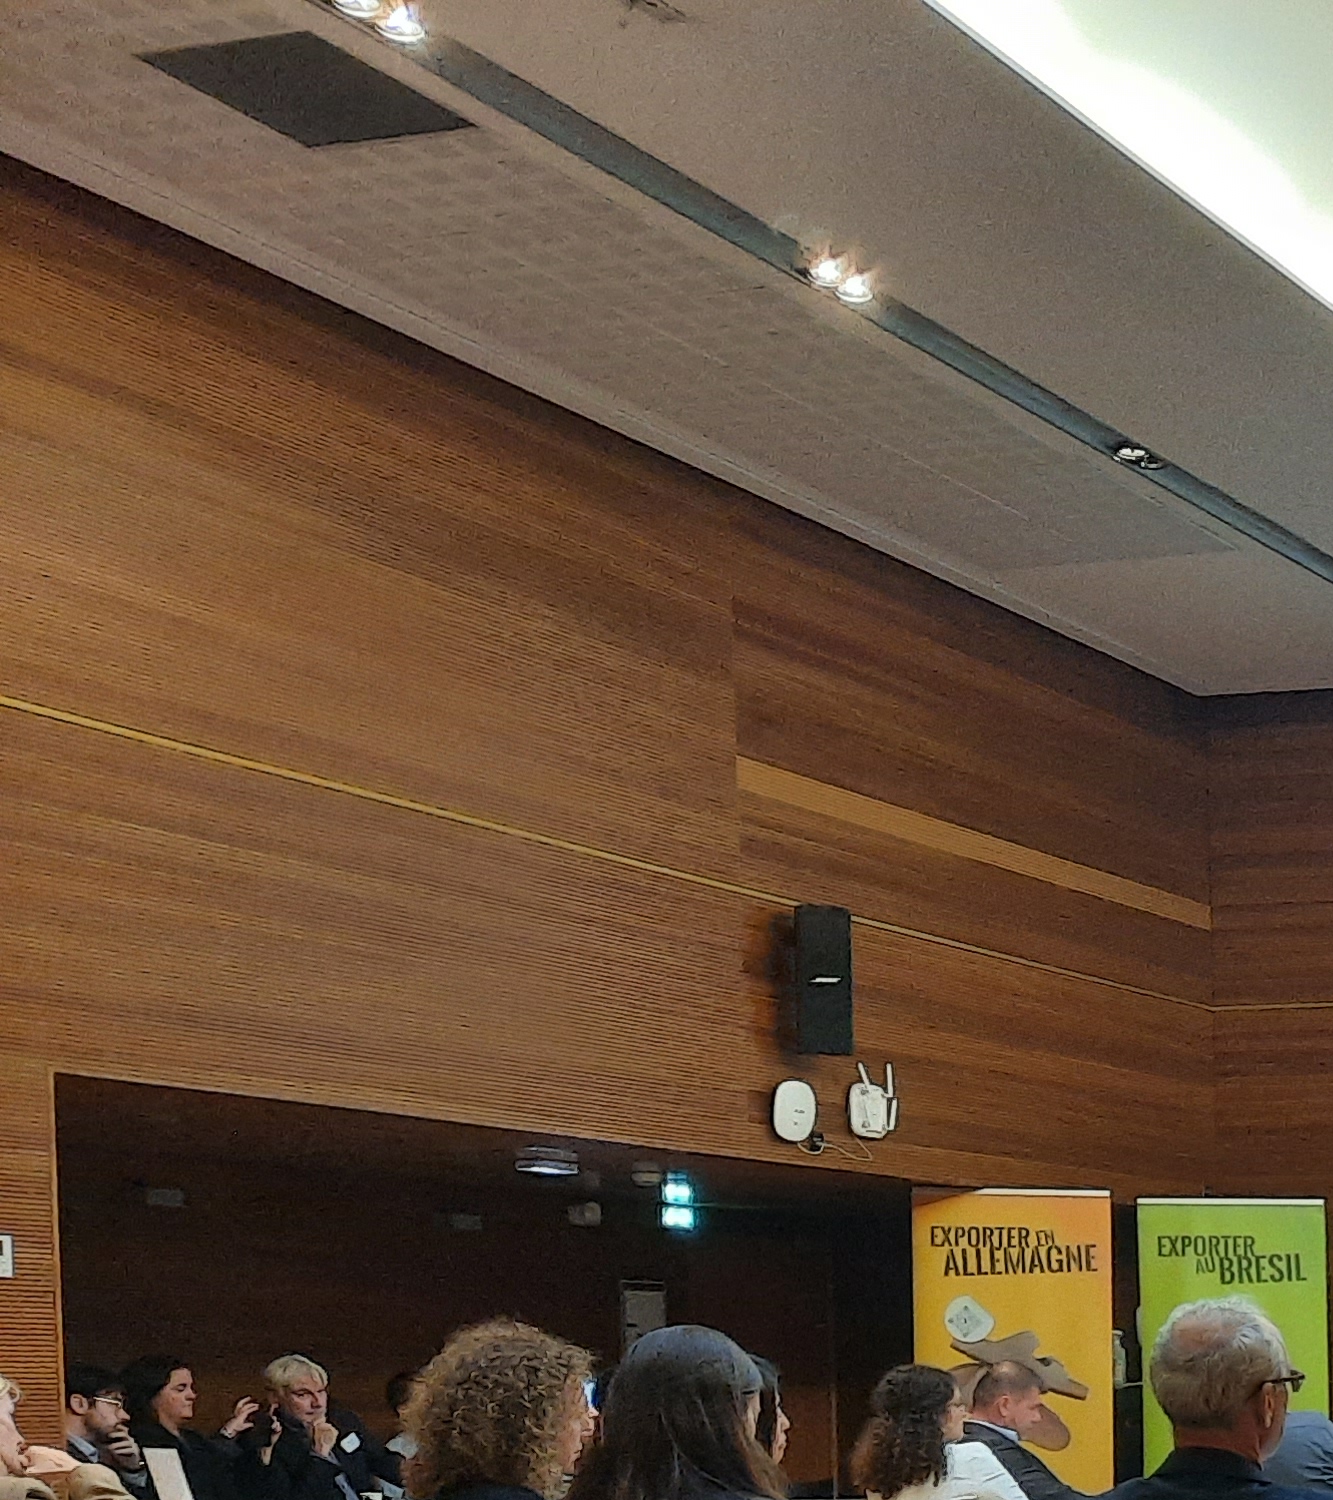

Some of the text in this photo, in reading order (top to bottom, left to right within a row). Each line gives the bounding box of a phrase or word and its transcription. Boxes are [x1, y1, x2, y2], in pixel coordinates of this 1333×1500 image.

[930, 1225, 1055, 1249] EXPORTER EN
[1157, 1235, 1256, 1258] EXPORTER
[943, 1244, 1099, 1277] ALLEMAGNE
[1195, 1253, 1308, 1285] AU BRESIL
